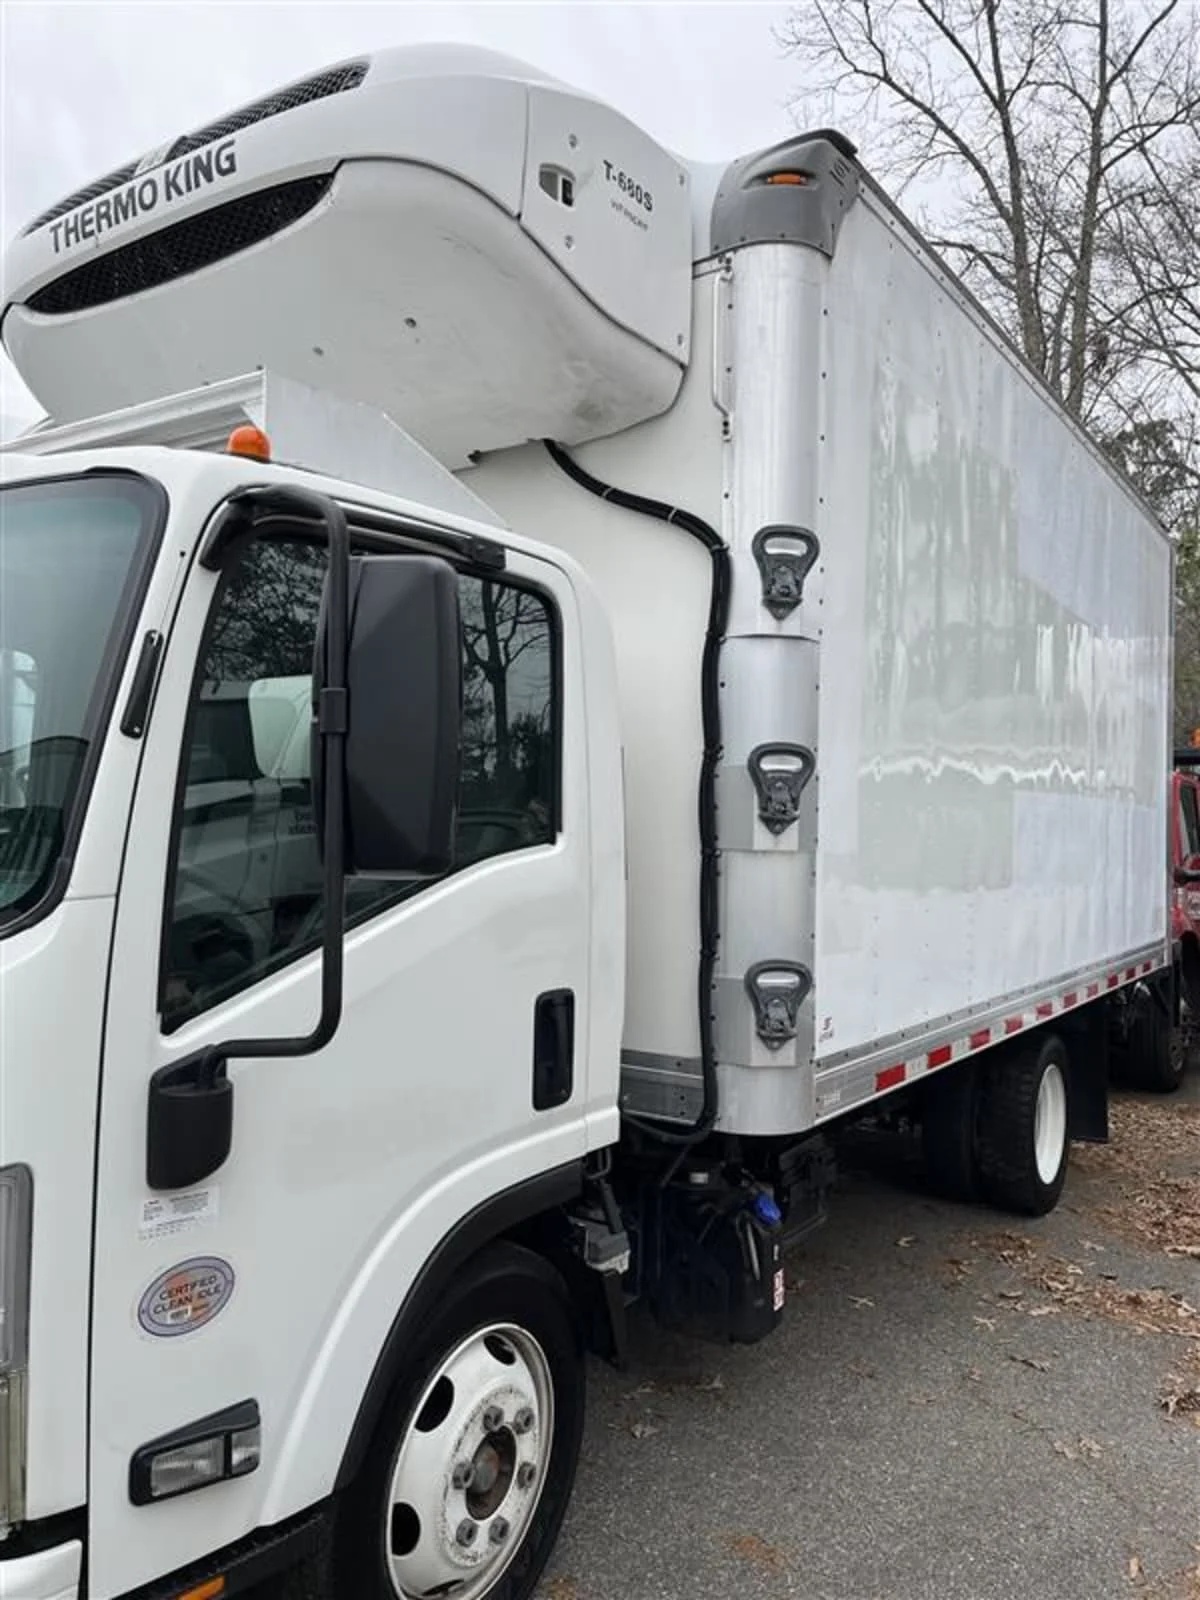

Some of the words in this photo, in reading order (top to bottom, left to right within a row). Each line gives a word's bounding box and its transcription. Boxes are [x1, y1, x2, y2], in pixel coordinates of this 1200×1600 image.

[50, 178, 158, 253] THERMO
[164, 140, 236, 202] KING
[603, 159, 652, 212] T-680S
[153, 1296, 193, 1314] CLEAN
[160, 1275, 217, 1300] CERTIFIED
